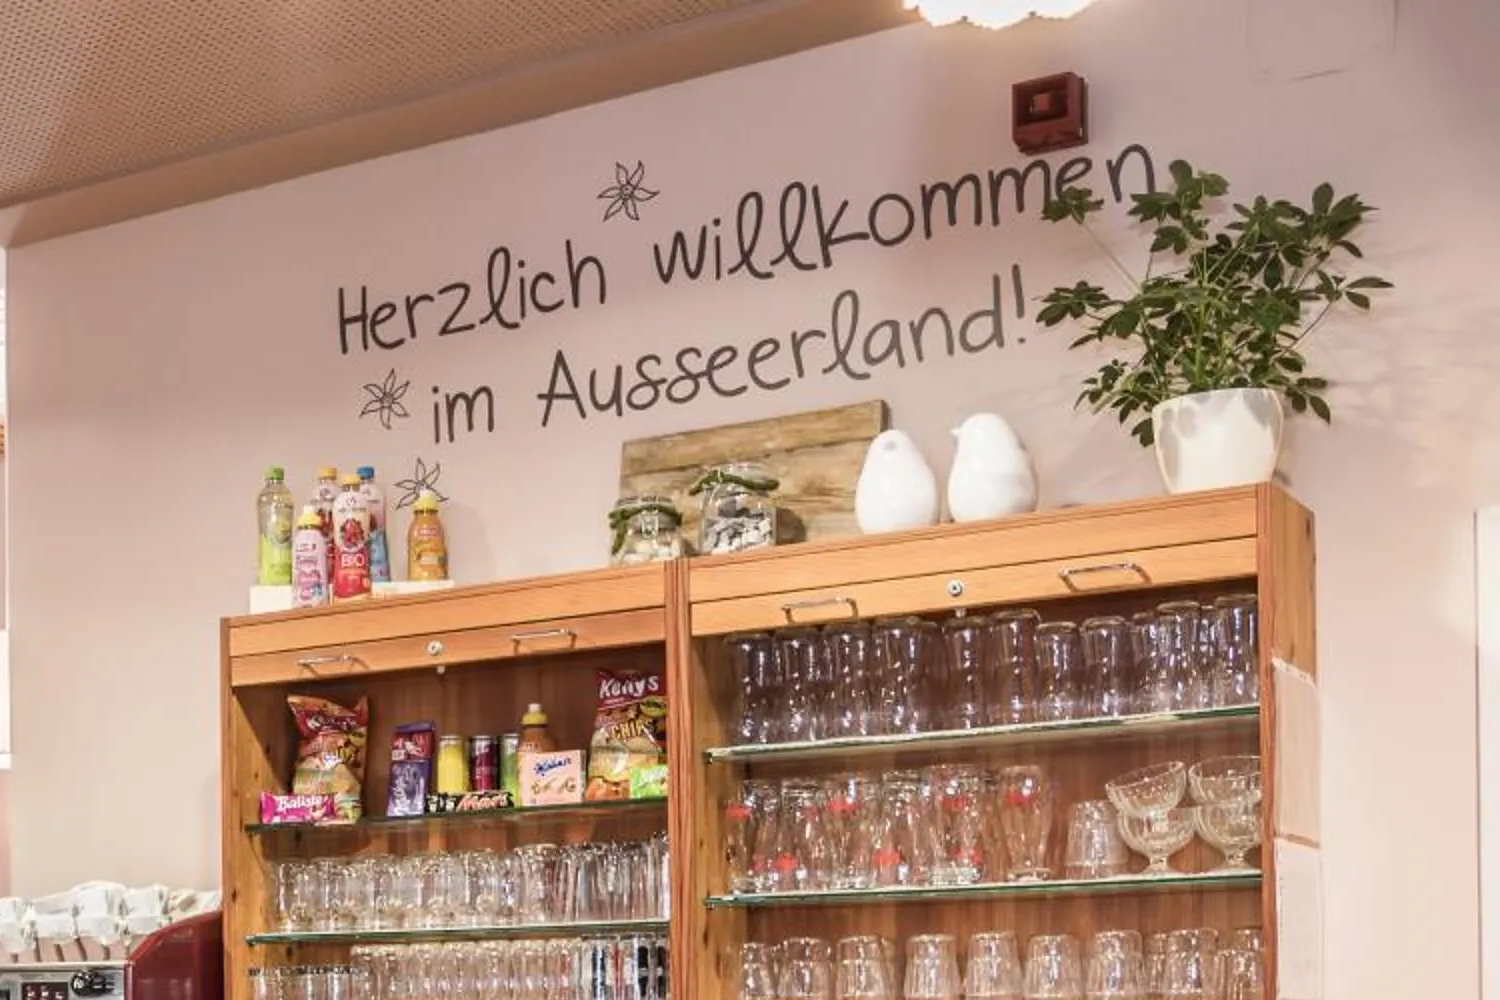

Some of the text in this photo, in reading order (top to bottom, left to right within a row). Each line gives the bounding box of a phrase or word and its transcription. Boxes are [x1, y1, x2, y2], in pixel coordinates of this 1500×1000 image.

[337, 143, 1156, 355] Herzlich willkommen
[431, 264, 1027, 445] im Ausseerland!
